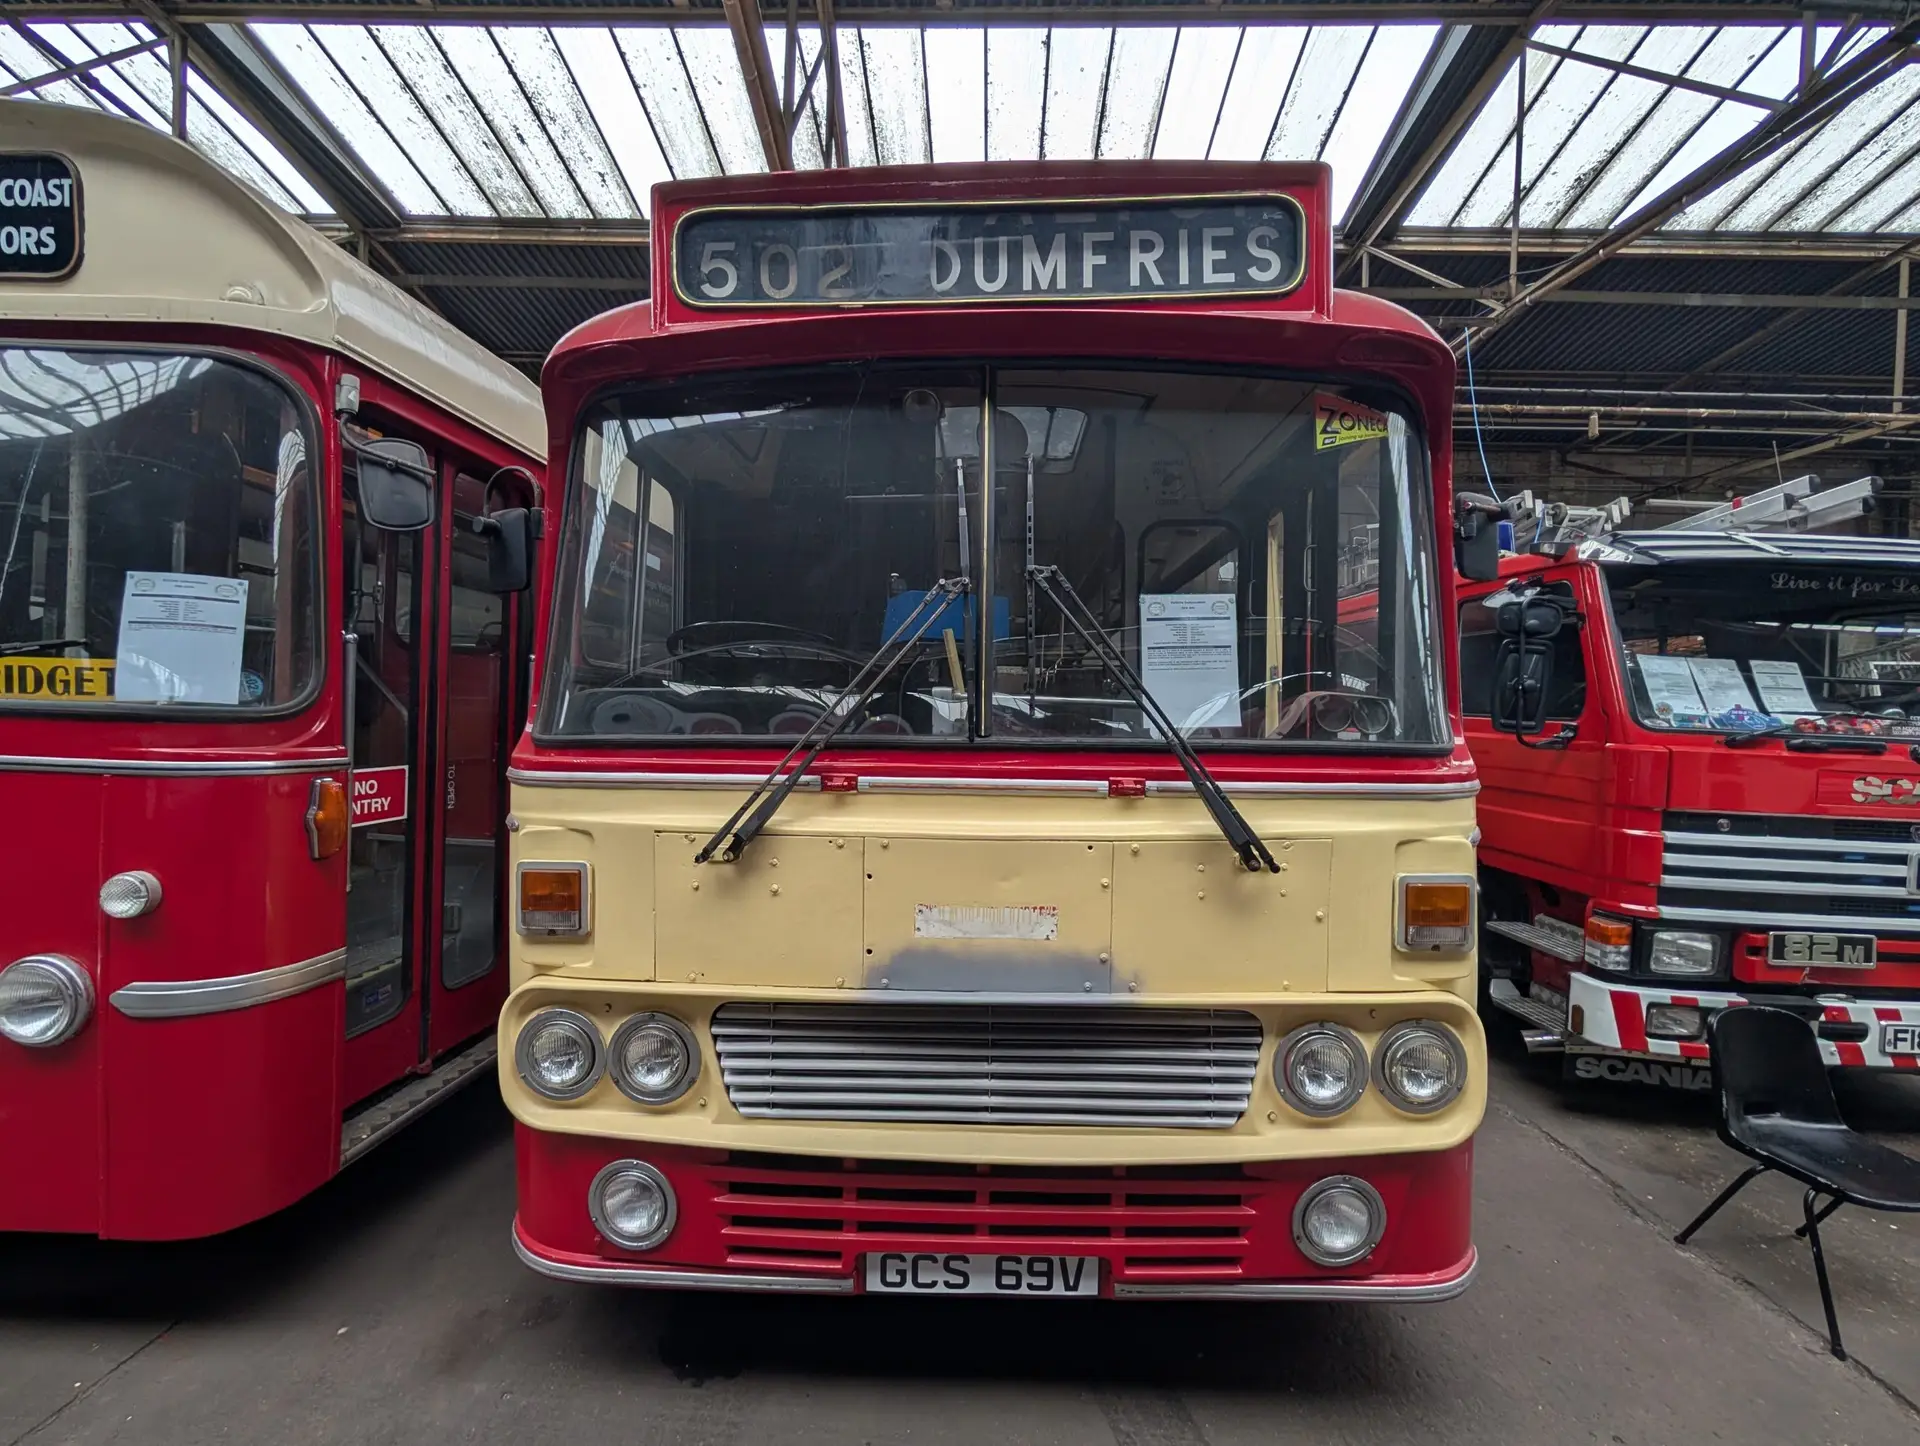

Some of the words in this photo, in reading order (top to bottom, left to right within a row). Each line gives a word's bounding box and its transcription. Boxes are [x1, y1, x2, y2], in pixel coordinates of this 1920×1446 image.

[0, 178, 72, 207] COAST
[930, 225, 1281, 293] DUMFRIES
[1771, 572, 1821, 589] Live
[1827, 576, 1844, 590] it
[1851, 576, 1886, 598] for
[1892, 577, 1920, 594] Le
[0, 664, 115, 696] IDGET
[448, 764, 455, 779] TO
[354, 779, 378, 796] NO
[447, 781, 455, 809] OPEN
[1784, 933, 1839, 962] 82
[1843, 944, 1865, 965] M
[1575, 1056, 1713, 1090] SCANIA
[880, 1253, 970, 1290] GCS
[995, 1256, 1085, 1292] 69V
